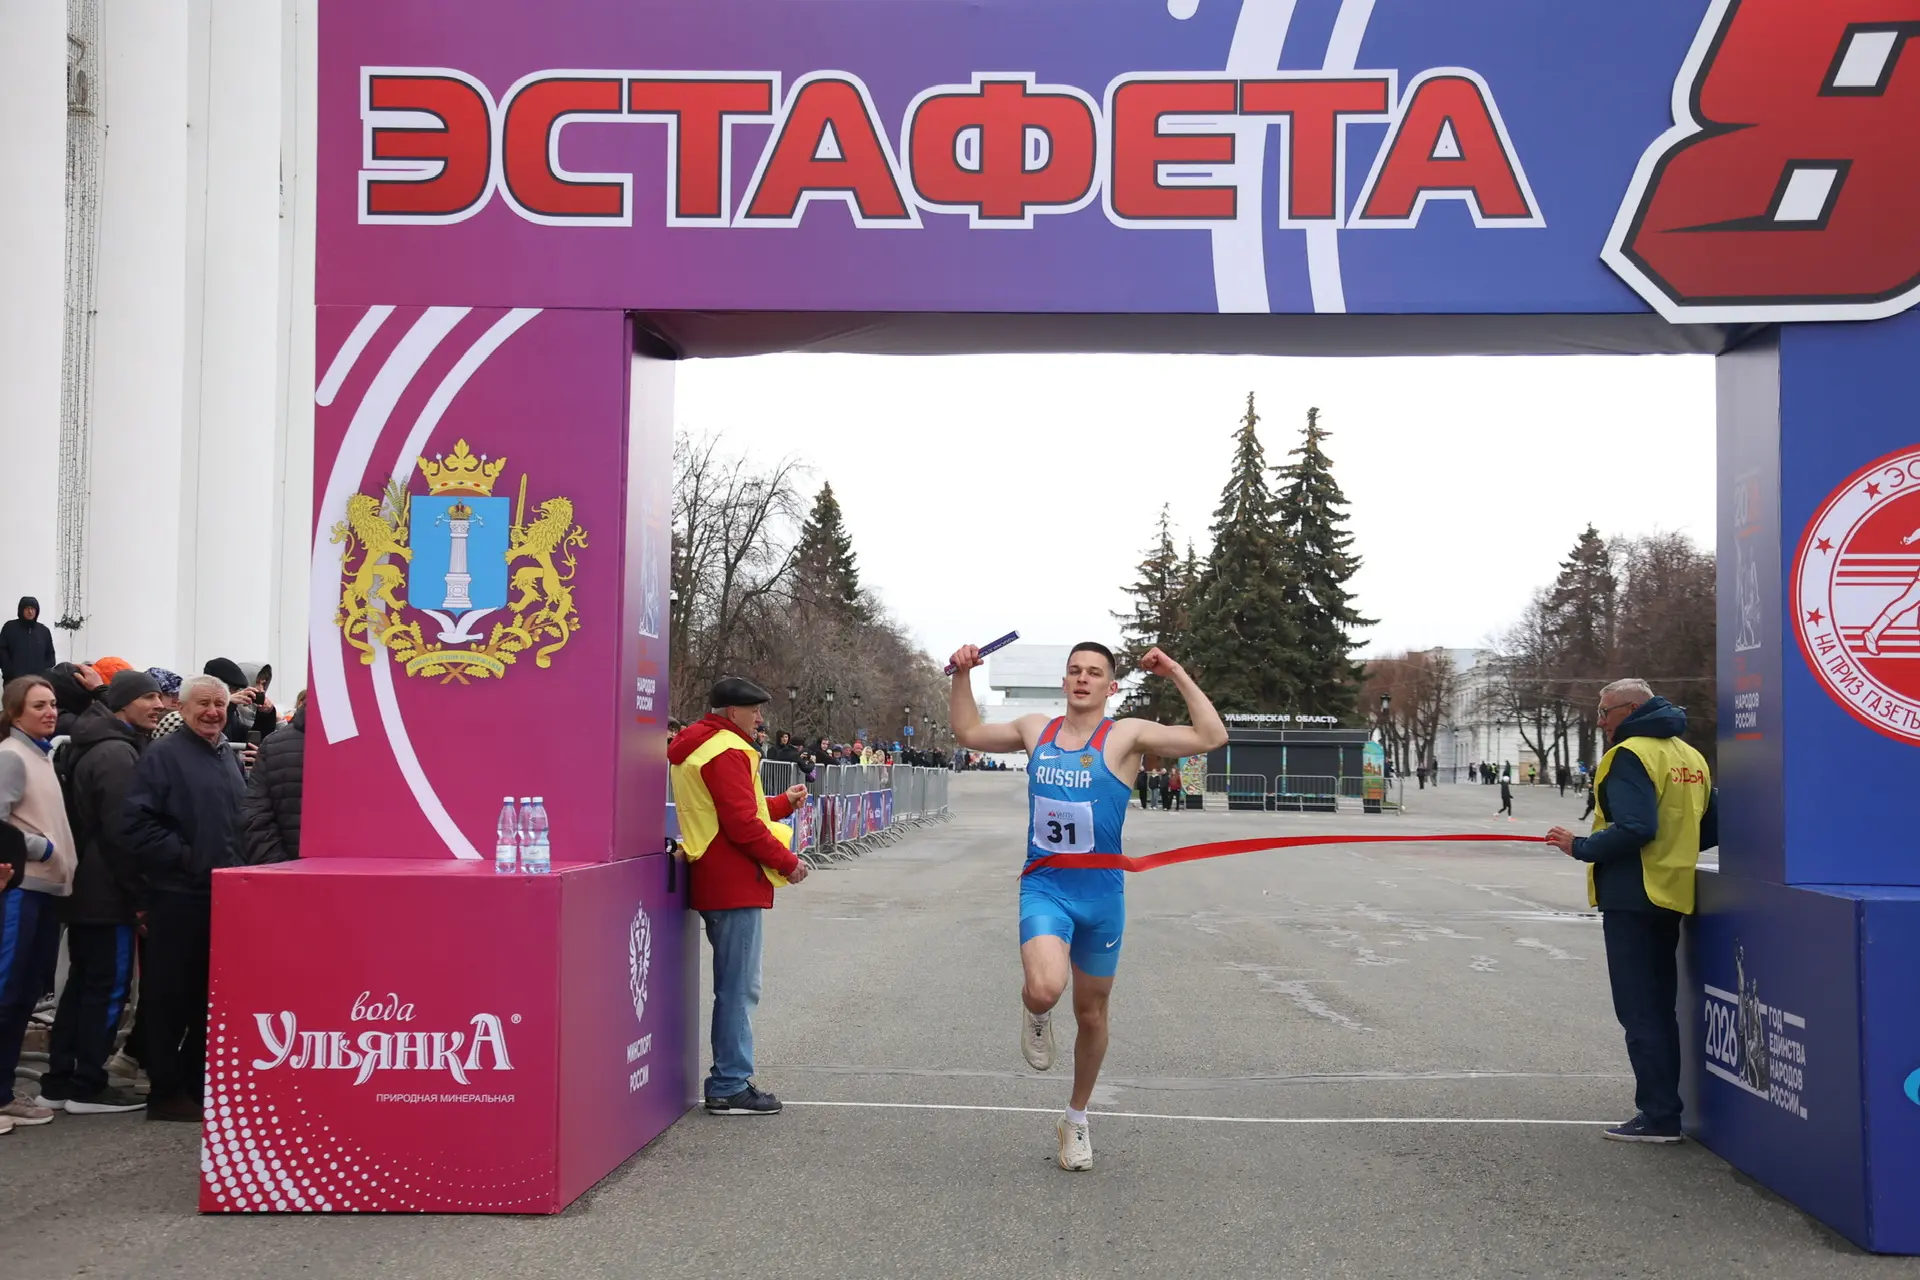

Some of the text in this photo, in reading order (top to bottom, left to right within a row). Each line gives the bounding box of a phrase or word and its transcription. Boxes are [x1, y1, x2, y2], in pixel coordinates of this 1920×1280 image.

[358, 64, 1546, 230] ЭСТАФЕТА
[1814, 633, 1836, 656] НА
[1826, 655, 1865, 696] ПРИЗ
[636, 695, 653, 711] РОССИИ
[1735, 692, 1760, 710] НАРОДОВ
[1224, 713, 1338, 723] УЛЬЯНОВСКАЯ ОБЛАСТЬ
[1735, 712, 1757, 729] РОССИИ
[1035, 765, 1093, 789] RUSSIA
[1046, 820, 1076, 845] 31
[351, 990, 417, 1022] вода
[1768, 1006, 1783, 1034] ГОД
[1704, 999, 1738, 1068] 2026
[626, 1033, 652, 1065] МИНСПОРТ
[1769, 1032, 1806, 1067] ЕДИНСТВА
[629, 1064, 649, 1094] РОССИИ
[1769, 1057, 1803, 1091] НАРОДОВ
[376, 1093, 515, 1104] ПРИРОДНАЯ МИНЕРАЛЬНАЯ
[1770, 1083, 1799, 1116] РОССИИ
